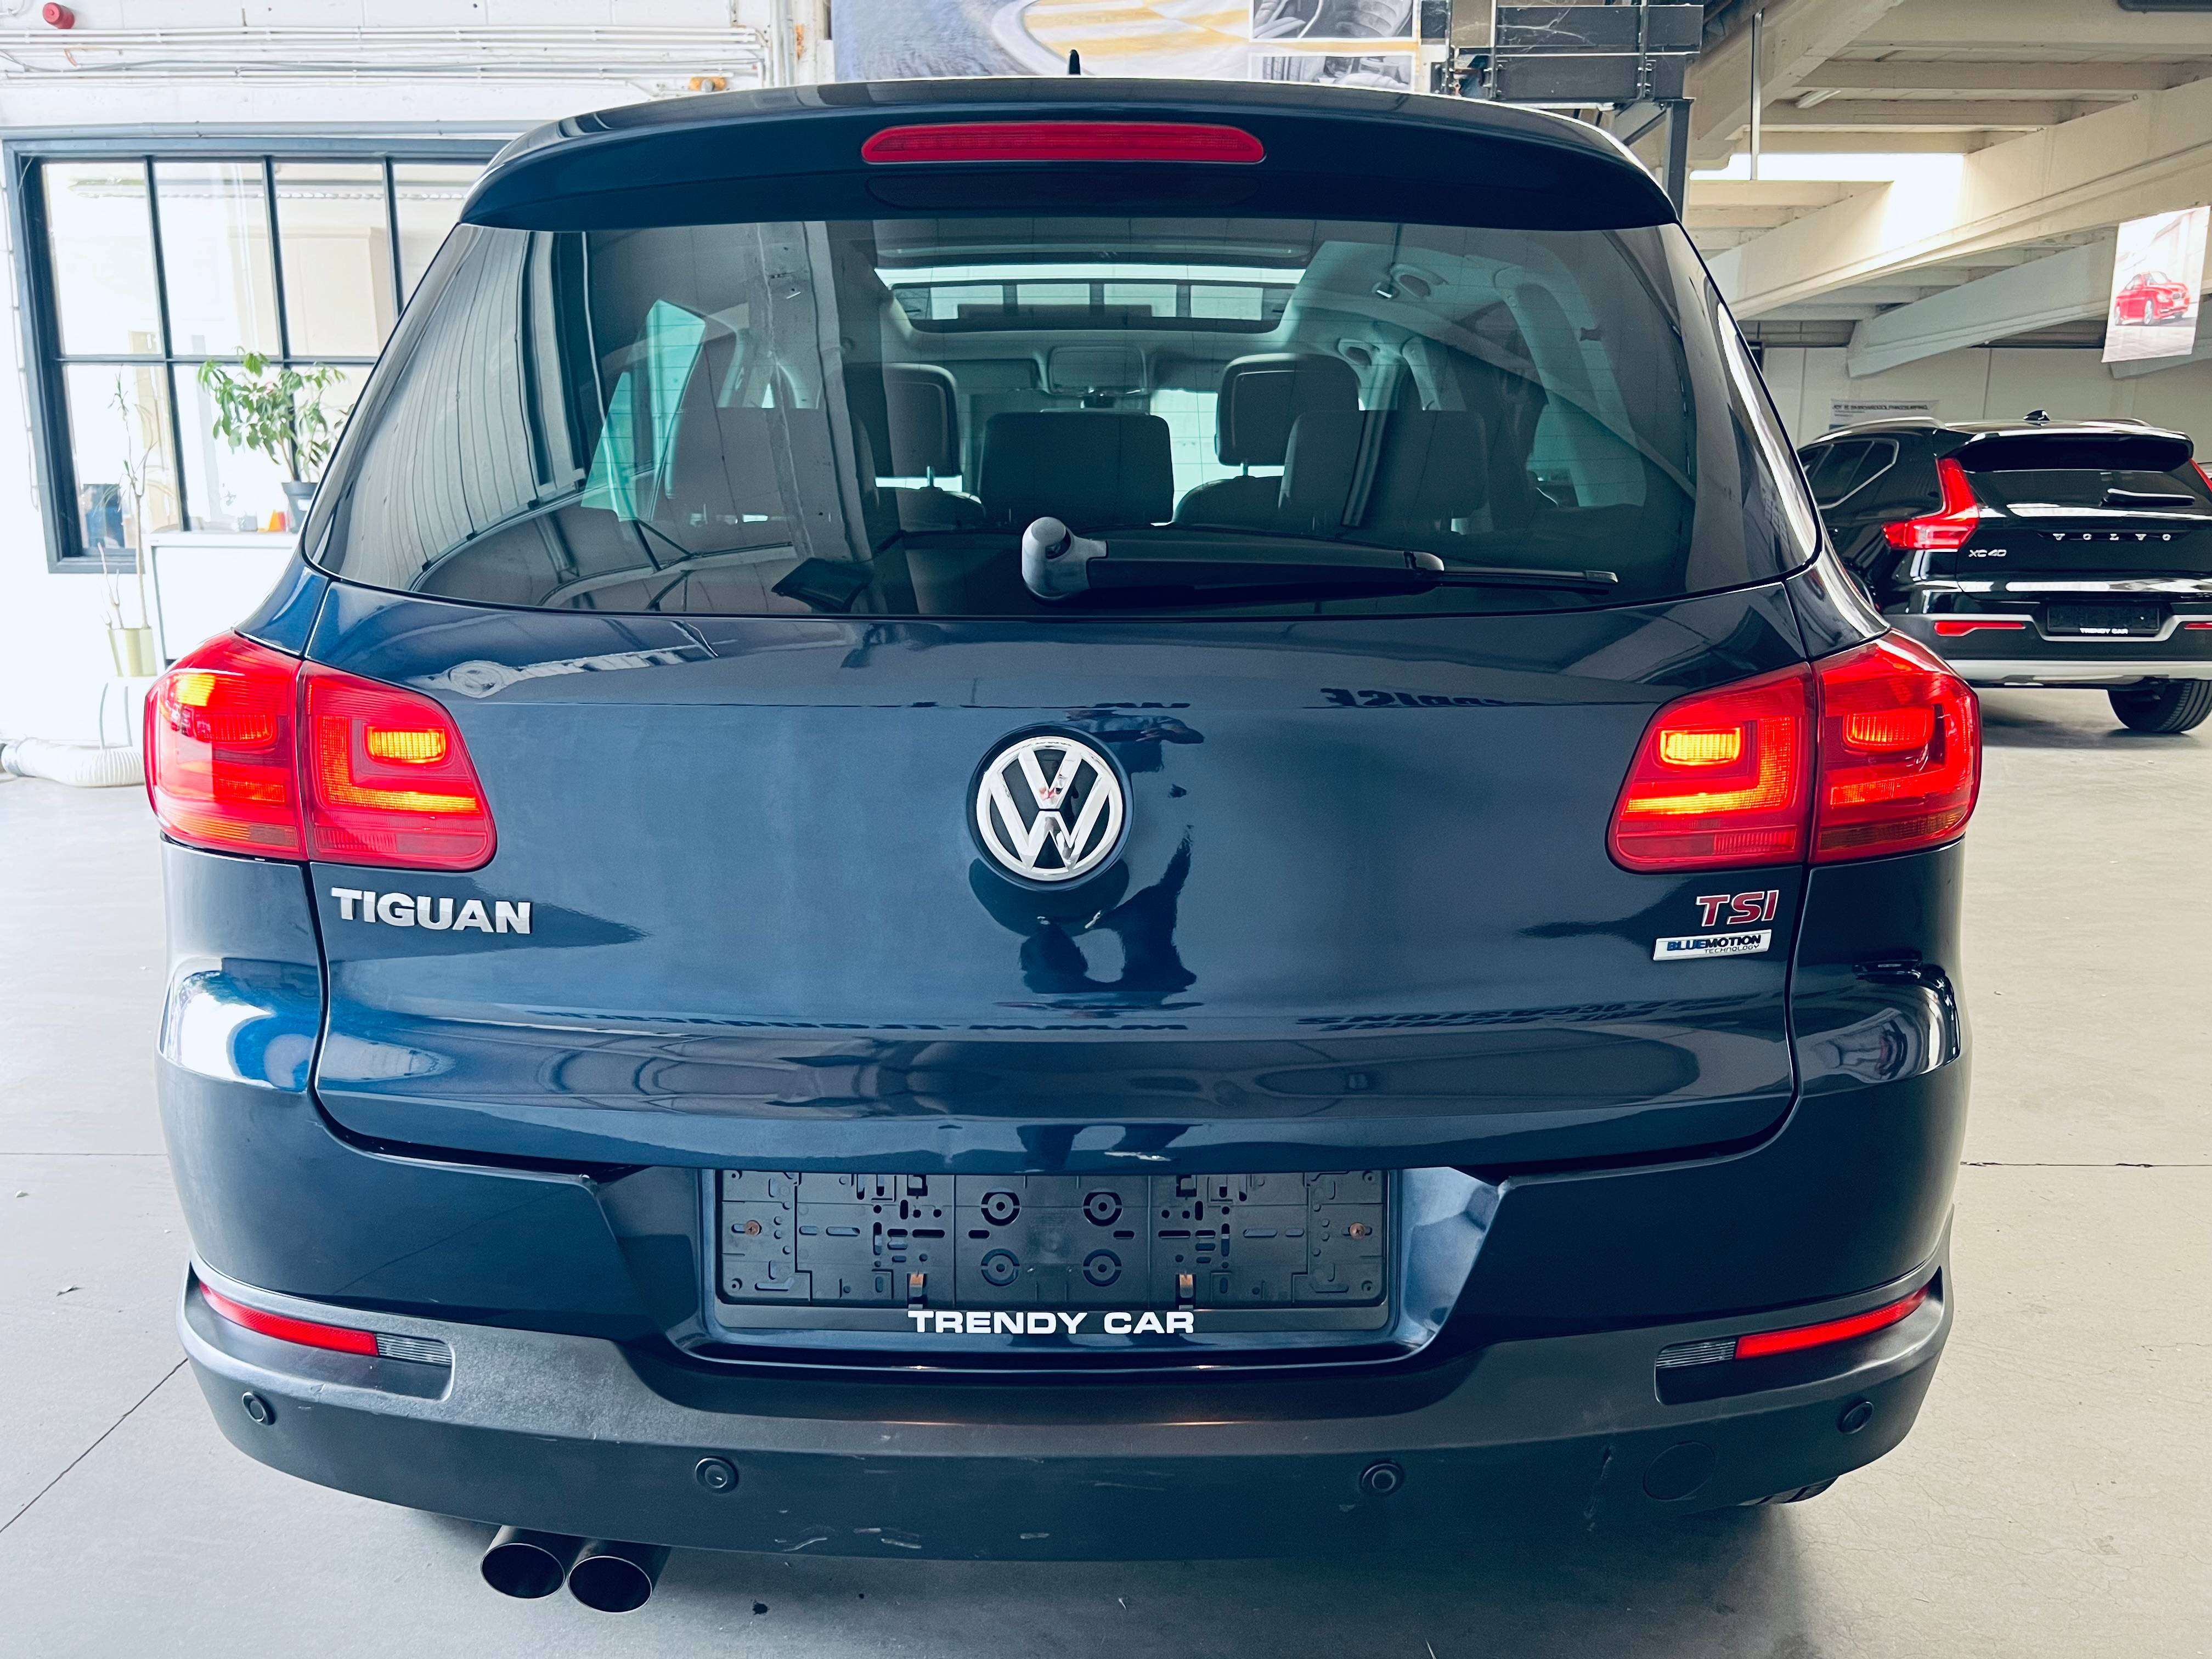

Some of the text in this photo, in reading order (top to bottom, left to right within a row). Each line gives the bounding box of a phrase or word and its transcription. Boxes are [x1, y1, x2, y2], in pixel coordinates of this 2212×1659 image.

[1968, 549, 2007, 557] XC40
[331, 887, 531, 934] TIGUAN
[1695, 890, 1779, 927] TSI
[1667, 935, 1762, 951] BLUEMOTION
[1705, 944, 1759, 953] TECHNOLOGY
[907, 1311, 1194, 1334] TRENDY CAR
